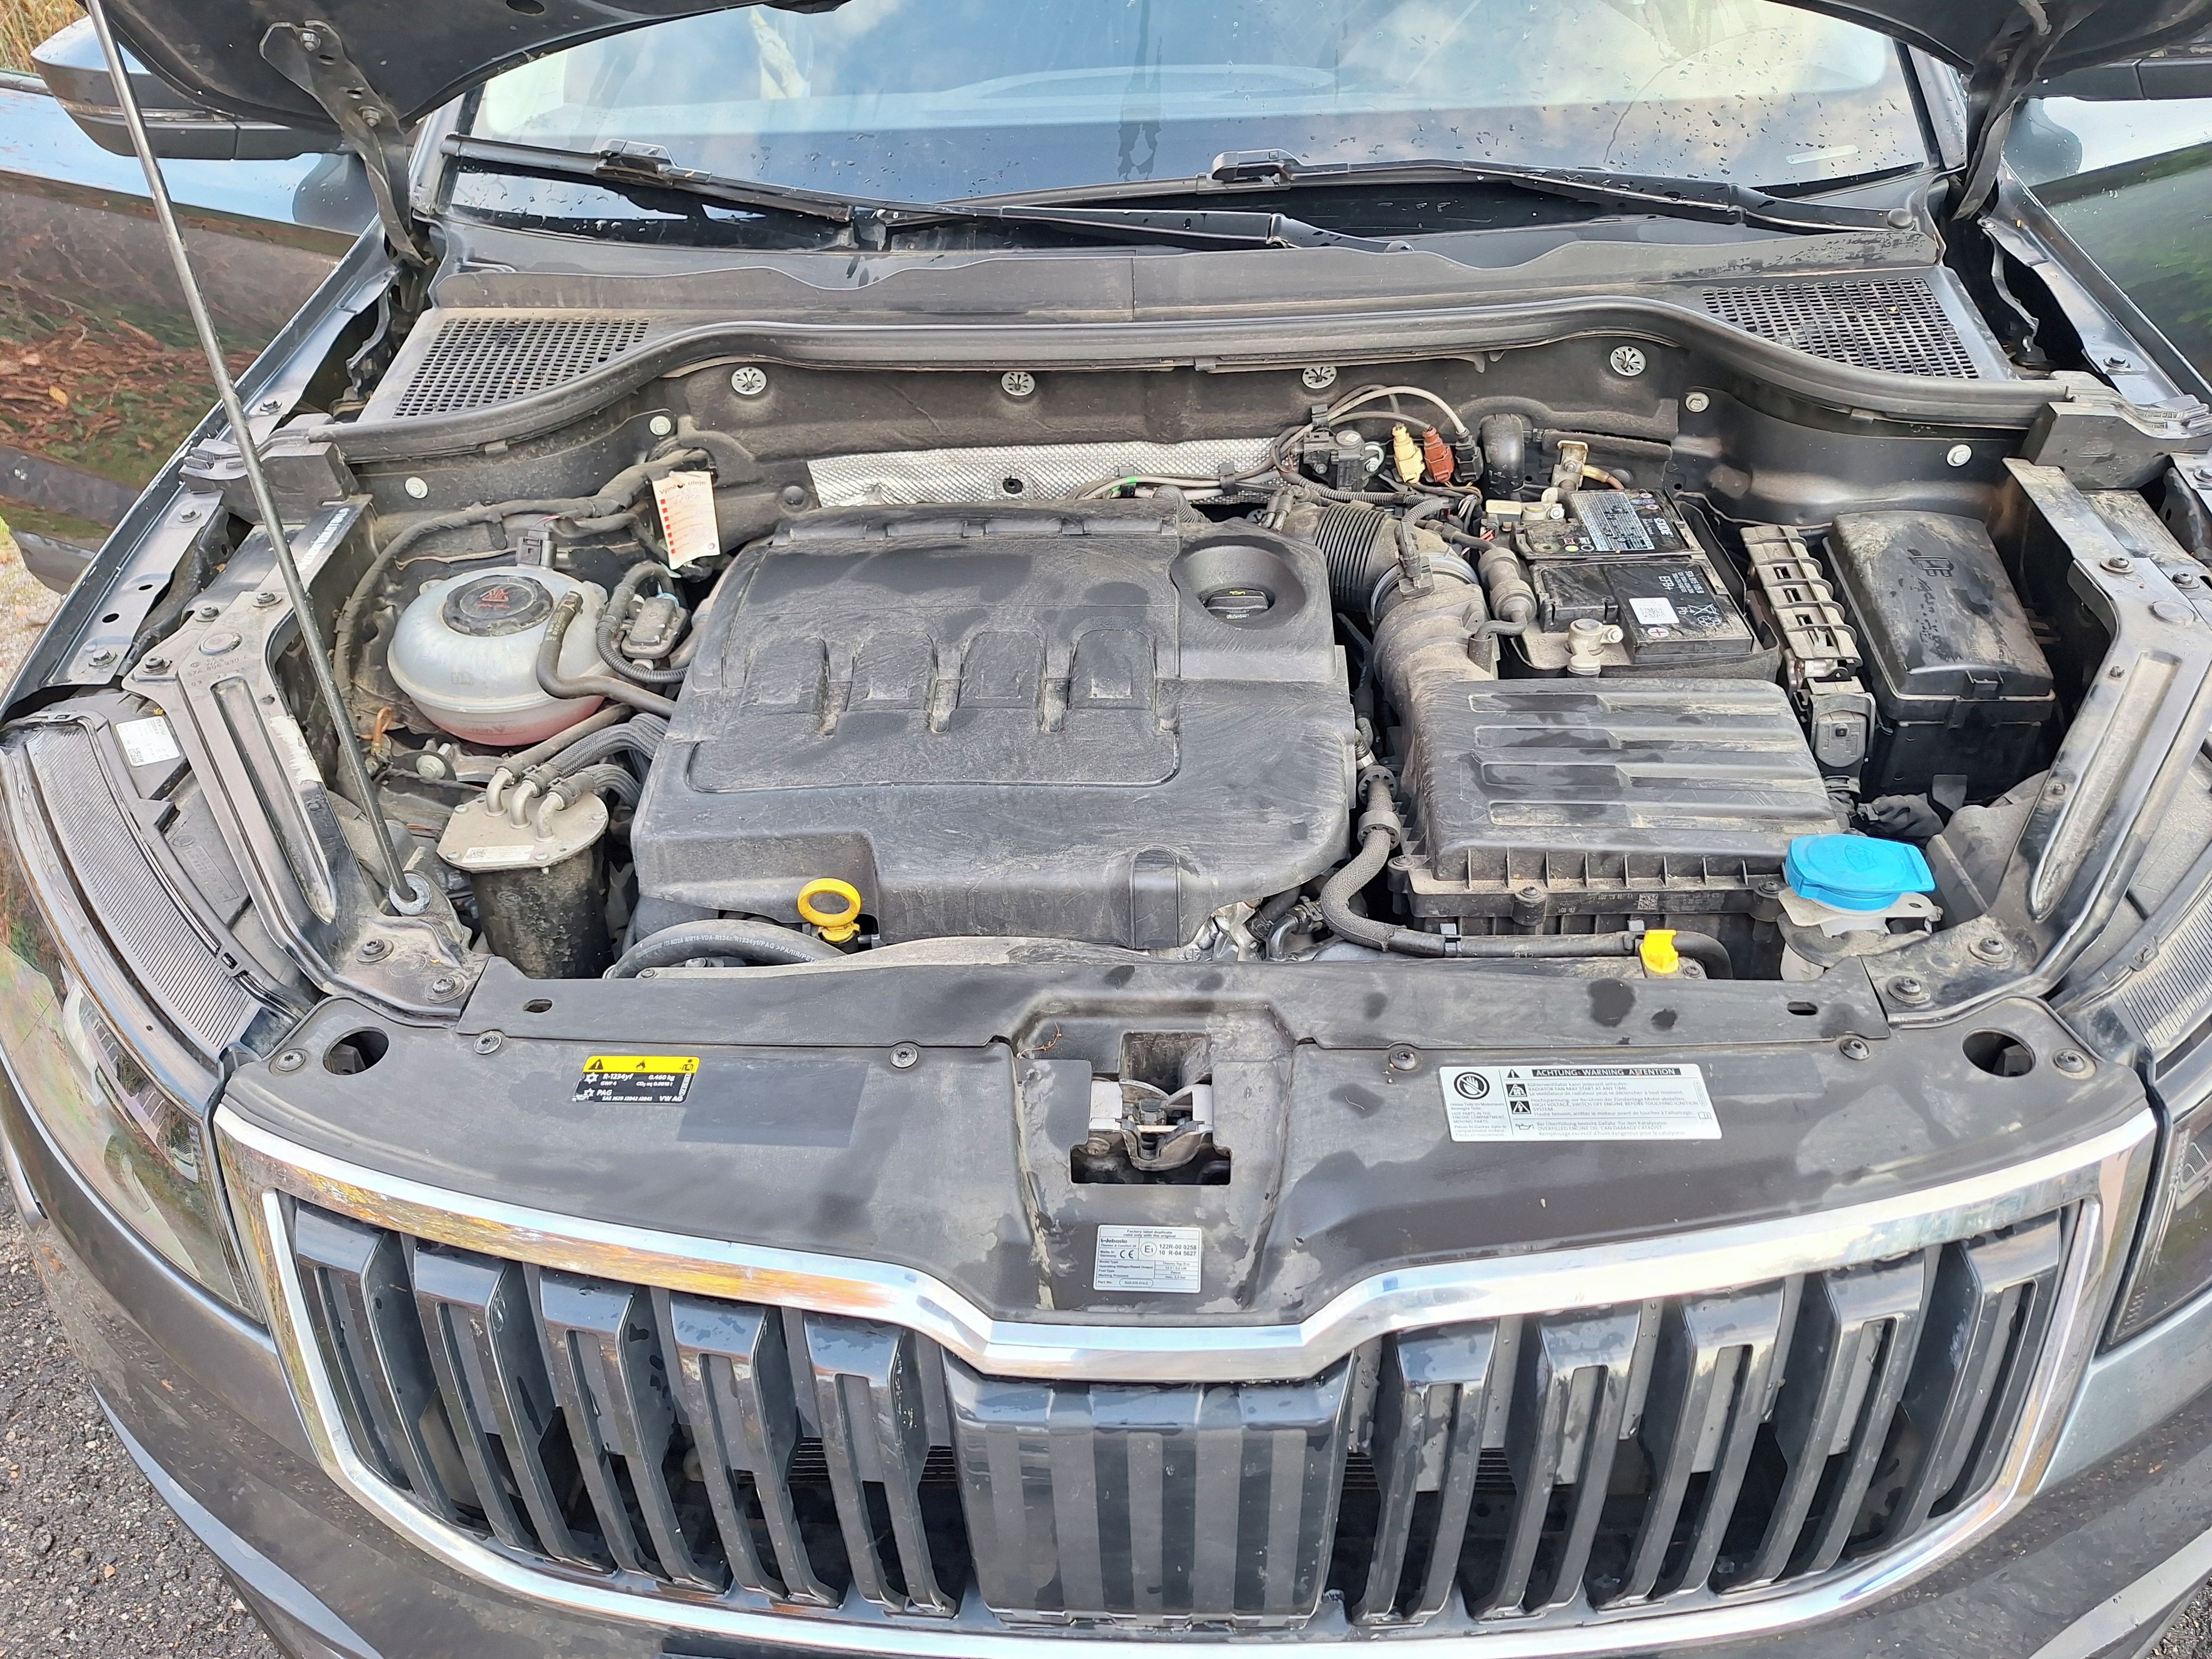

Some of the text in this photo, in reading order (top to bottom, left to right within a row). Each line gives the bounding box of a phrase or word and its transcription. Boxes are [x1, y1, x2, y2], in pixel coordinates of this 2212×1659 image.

[659, 483, 685, 494] Výměa
[1653, 518, 1673, 536] EXIDE
[1658, 576, 1675, 590] EFB+
[1676, 607, 1687, 615] Pb
